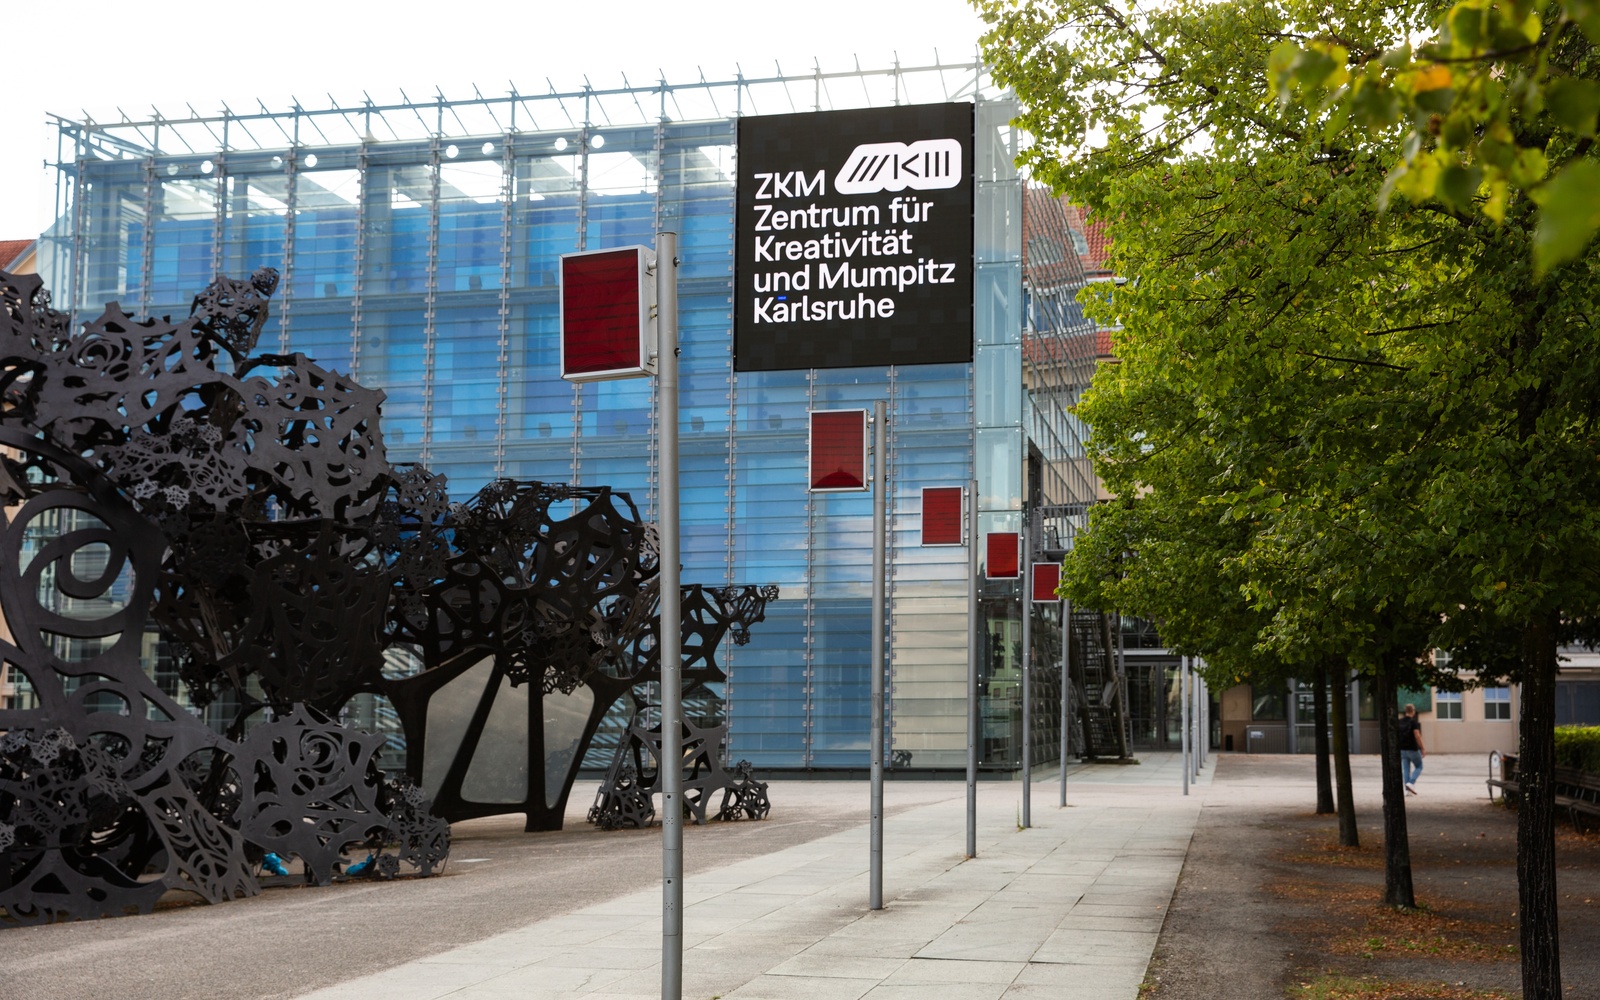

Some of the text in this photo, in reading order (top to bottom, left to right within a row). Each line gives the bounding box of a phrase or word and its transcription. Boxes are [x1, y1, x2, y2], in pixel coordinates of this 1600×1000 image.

[754, 170, 826, 200] ZKM
[754, 197, 934, 232] Zentrum für
[754, 229, 913, 263] Kreativität
[753, 257, 956, 293] und Mumpitz
[753, 293, 895, 324] Karlsruhe
